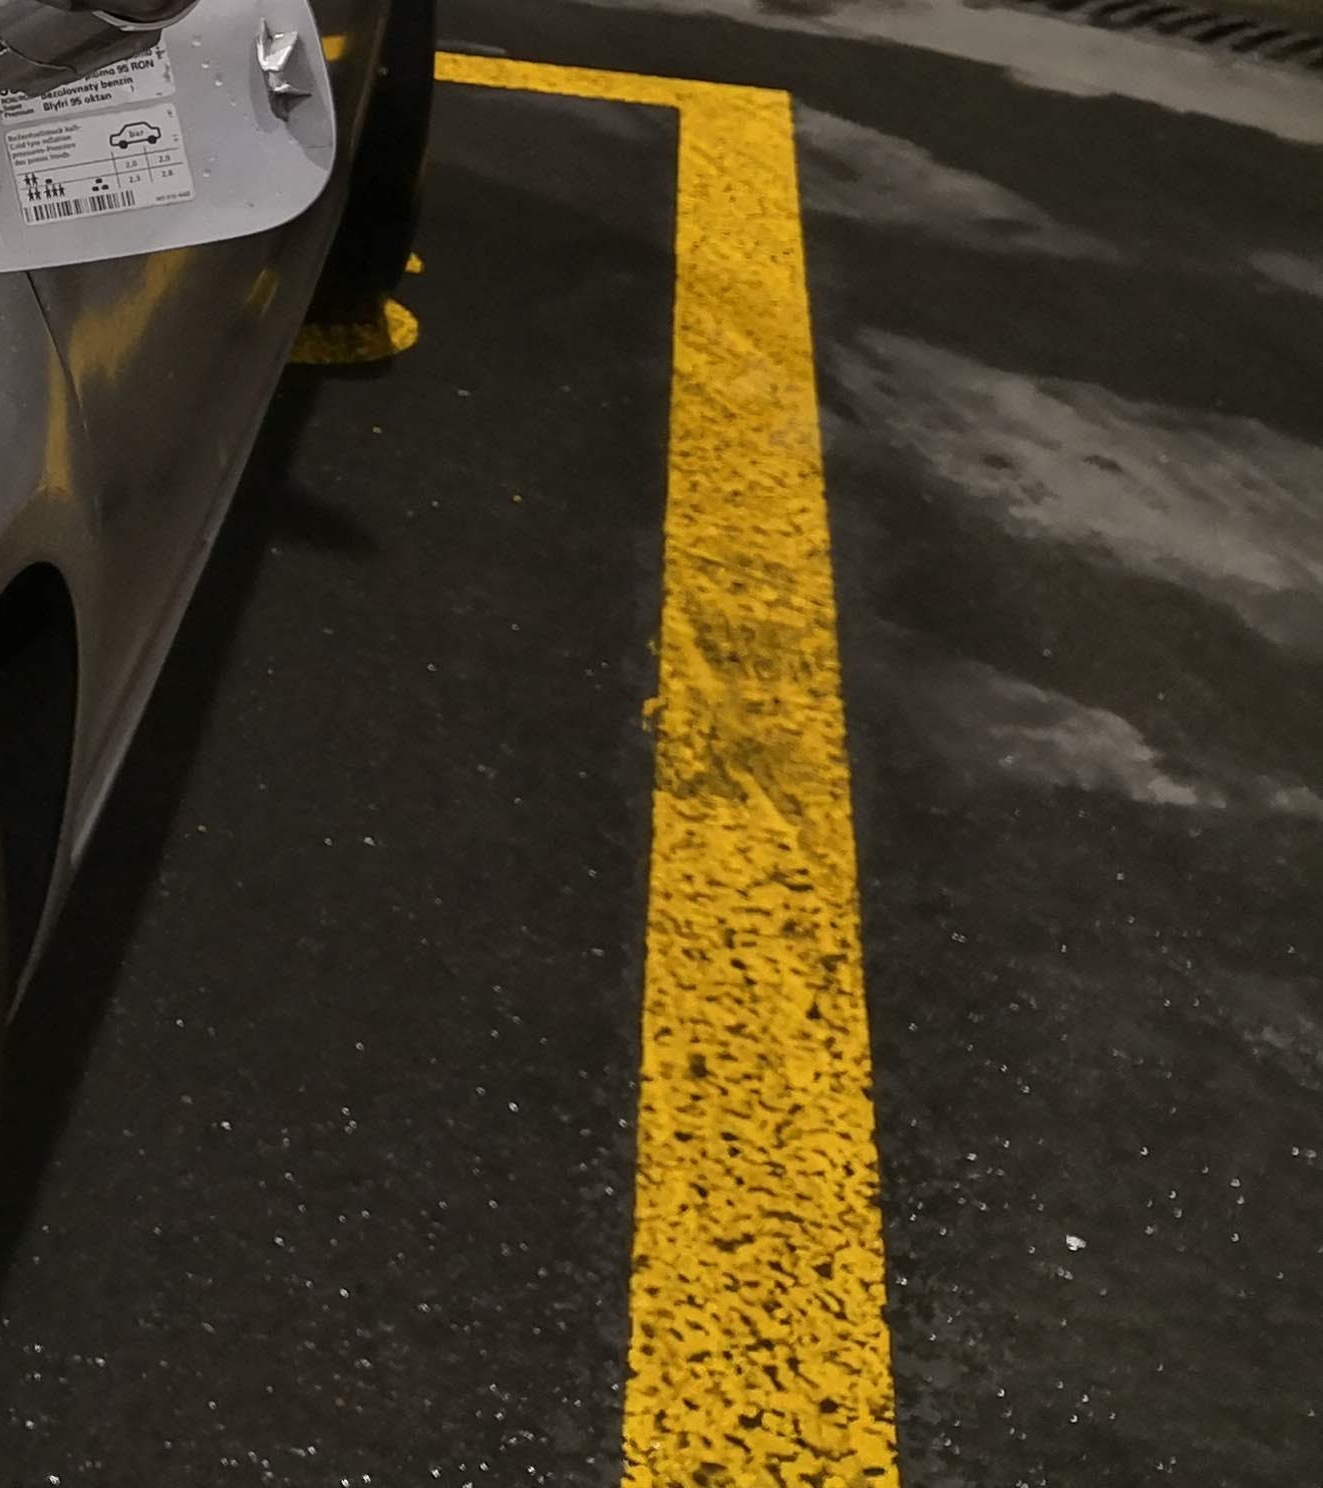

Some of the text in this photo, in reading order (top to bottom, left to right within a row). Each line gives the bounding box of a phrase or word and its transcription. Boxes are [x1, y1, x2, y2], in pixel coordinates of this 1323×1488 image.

[131, 59, 154, 71] RON
[100, 76, 133, 89] benzin
[84, 91, 112, 104] oktan
